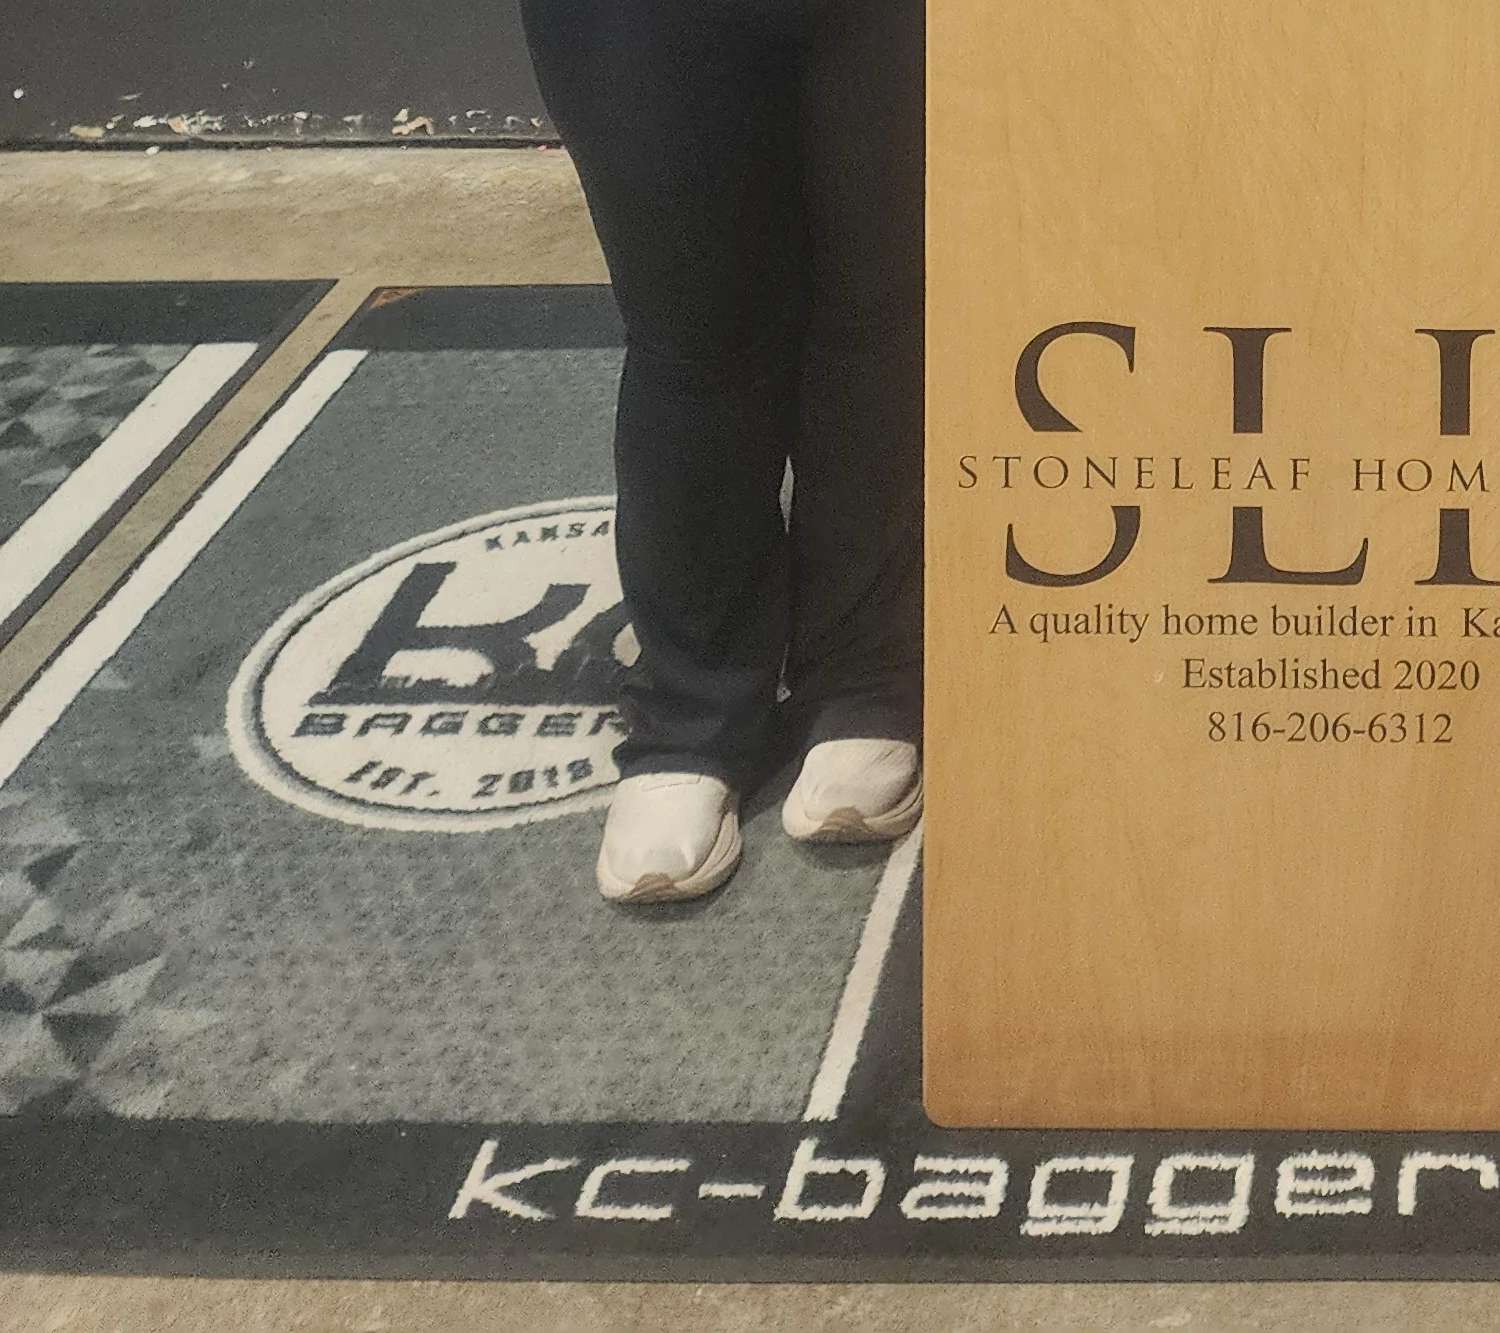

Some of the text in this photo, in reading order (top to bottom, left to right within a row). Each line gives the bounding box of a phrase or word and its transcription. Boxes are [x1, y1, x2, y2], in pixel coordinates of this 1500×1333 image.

[957, 454, 1312, 492] STONELEAF
[484, 519, 612, 552] KANSA
[988, 604, 1018, 636] A
[1028, 603, 1150, 644] quality
[1161, 603, 1259, 637] home
[1270, 604, 1395, 638] builder
[1405, 605, 1438, 638] in
[1182, 657, 1481, 692] Established 2020
[292, 710, 632, 738] BAGGER
[1207, 710, 1454, 745] 816-206-6312
